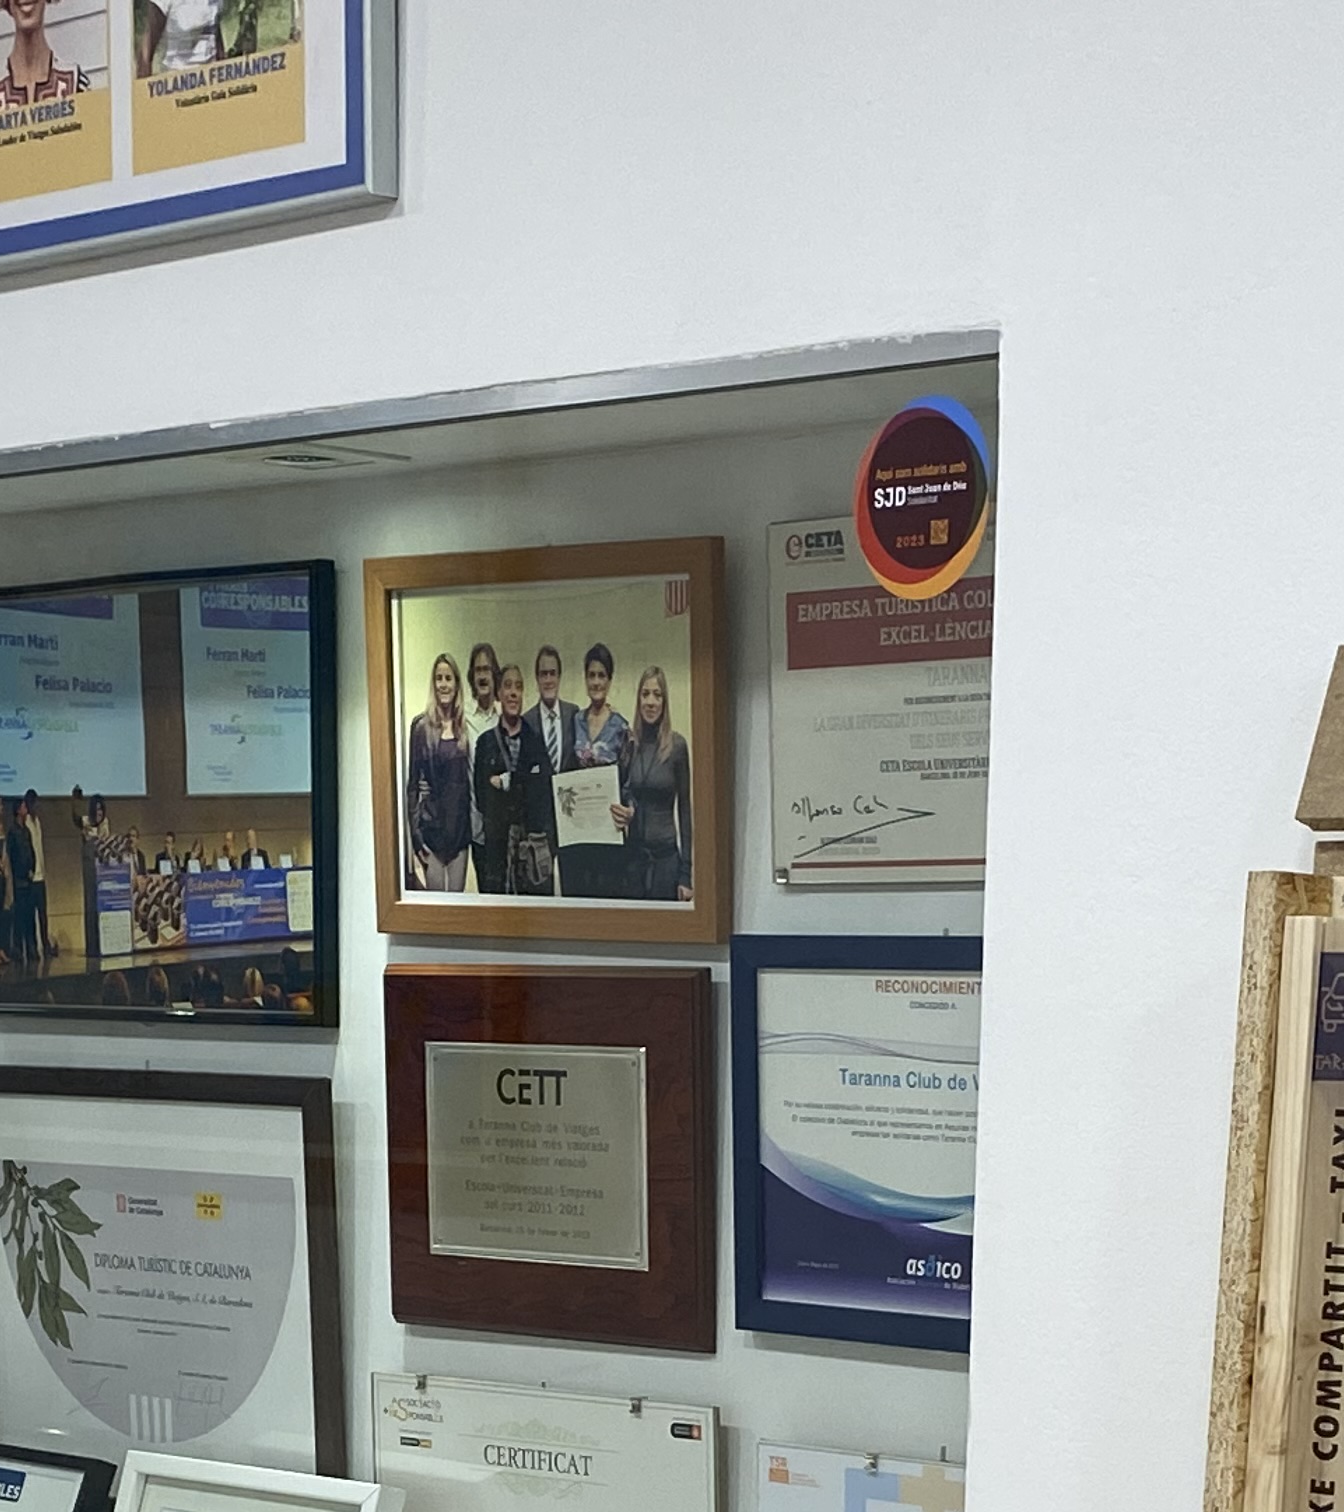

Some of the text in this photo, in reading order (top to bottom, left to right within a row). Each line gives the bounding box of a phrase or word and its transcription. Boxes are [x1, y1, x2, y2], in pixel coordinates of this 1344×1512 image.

[147, 70, 206, 98] YOLANDA
[874, 486, 907, 509] SJD
[804, 529, 844, 549] CETA
[797, 598, 872, 623] EMPRESA
[496, 1067, 568, 1106] CETT
[839, 1067, 968, 1092] Taranna Club de
[906, 1254, 962, 1280] asdico
[483, 1444, 593, 1477] CERTIFICAT
